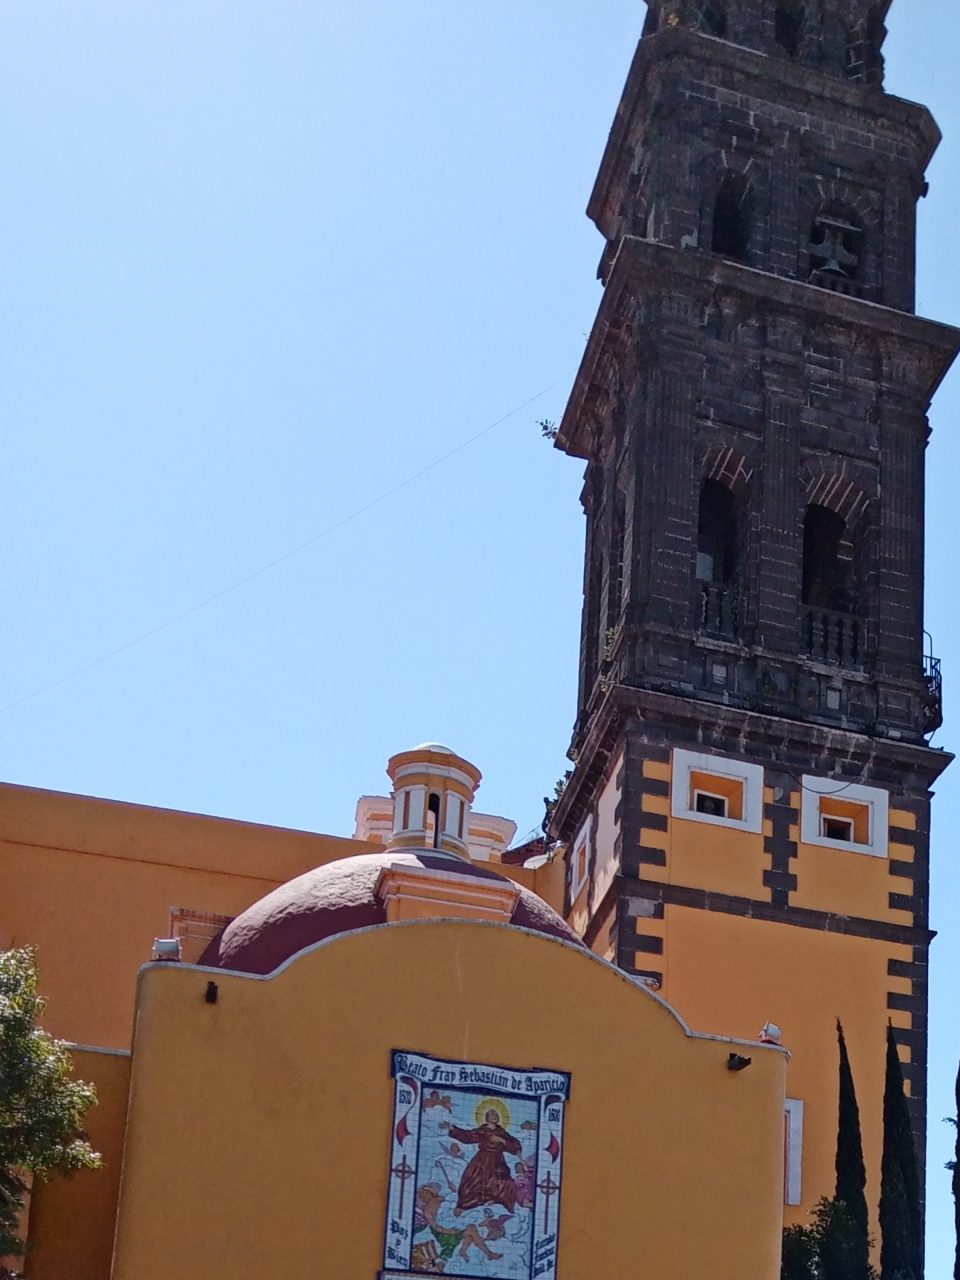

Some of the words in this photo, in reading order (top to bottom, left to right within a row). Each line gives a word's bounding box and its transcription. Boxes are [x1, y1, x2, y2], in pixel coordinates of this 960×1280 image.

[396, 1055, 427, 1078] Beato
[428, 1065, 456, 1082] Fray
[459, 1066, 508, 1089] Sebastián
[511, 1077, 522, 1091] de
[525, 1077, 566, 1095] Aparicio
